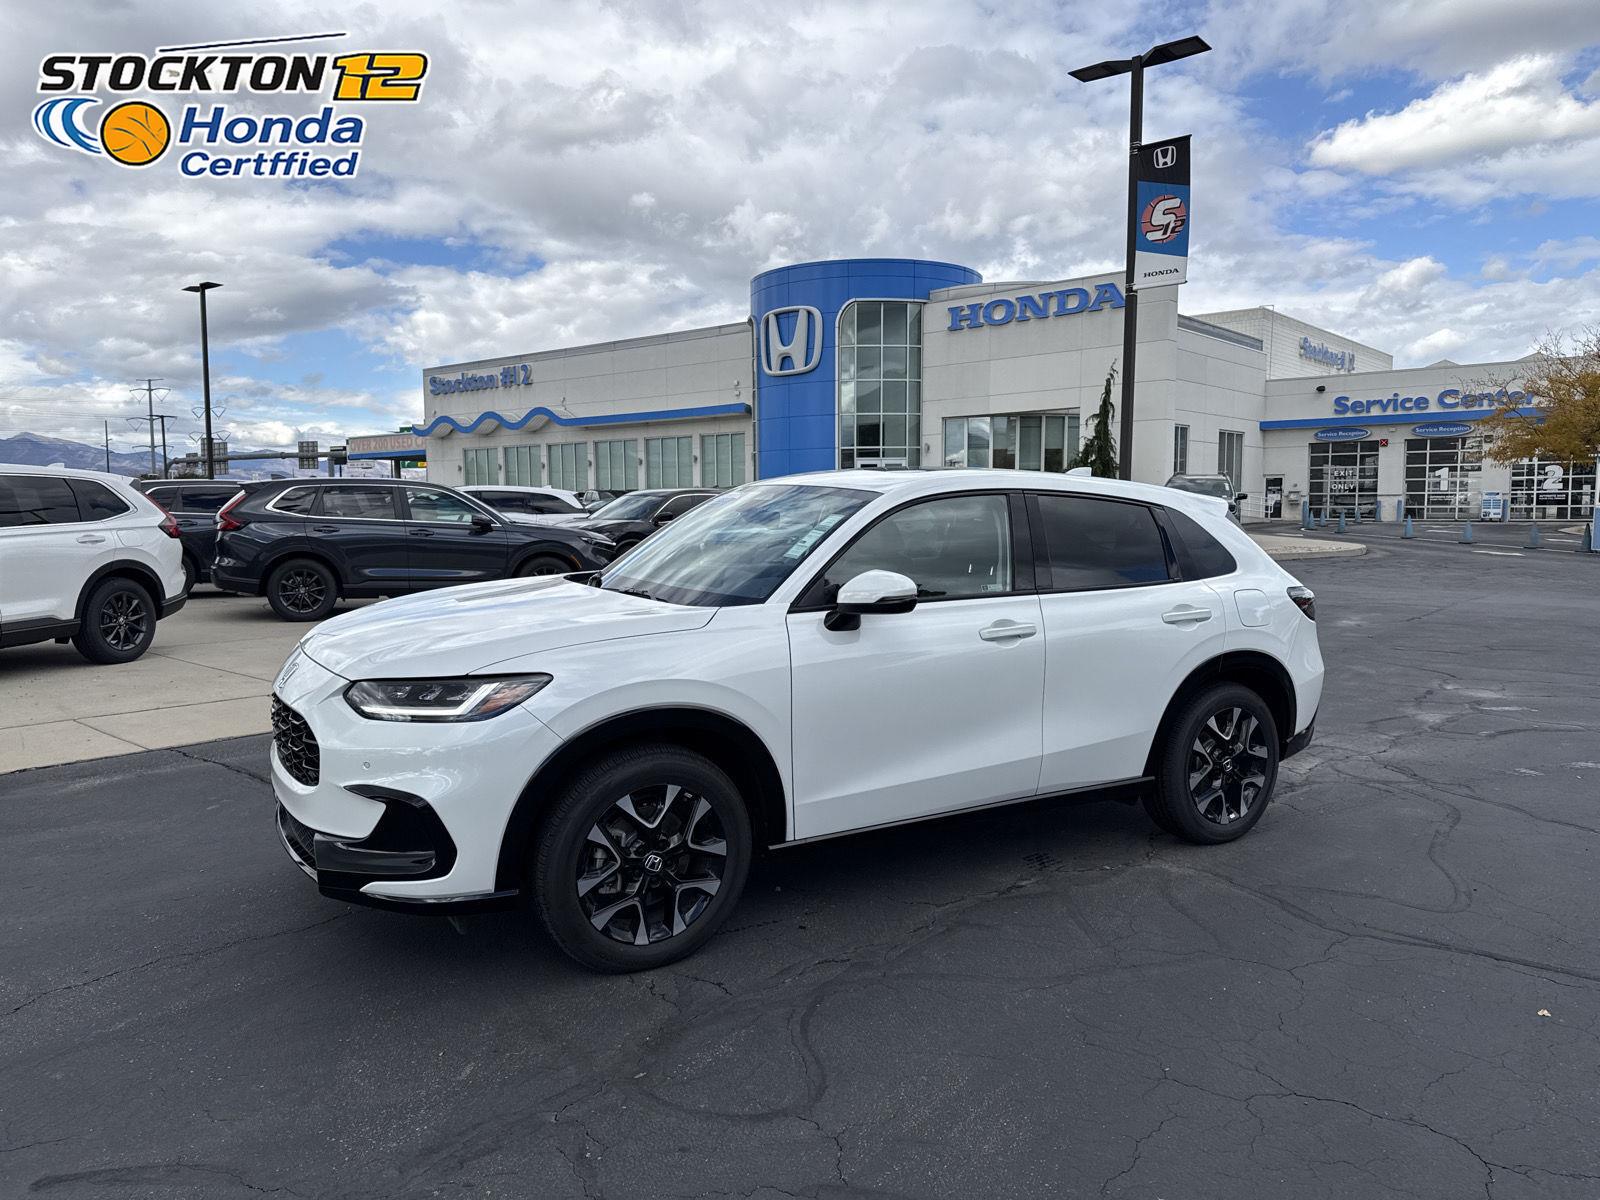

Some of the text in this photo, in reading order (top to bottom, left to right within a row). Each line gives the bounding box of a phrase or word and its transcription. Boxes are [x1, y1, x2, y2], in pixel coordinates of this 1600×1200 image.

[1143, 268, 1179, 278] HONDA
[948, 282, 1126, 331] HONDA
[429, 372, 499, 396] Stockton
[1334, 393, 1430, 415] Service
[1438, 425, 1470, 433] Reception
[1435, 467, 1449, 491] 1
[1542, 465, 1563, 490] 2
